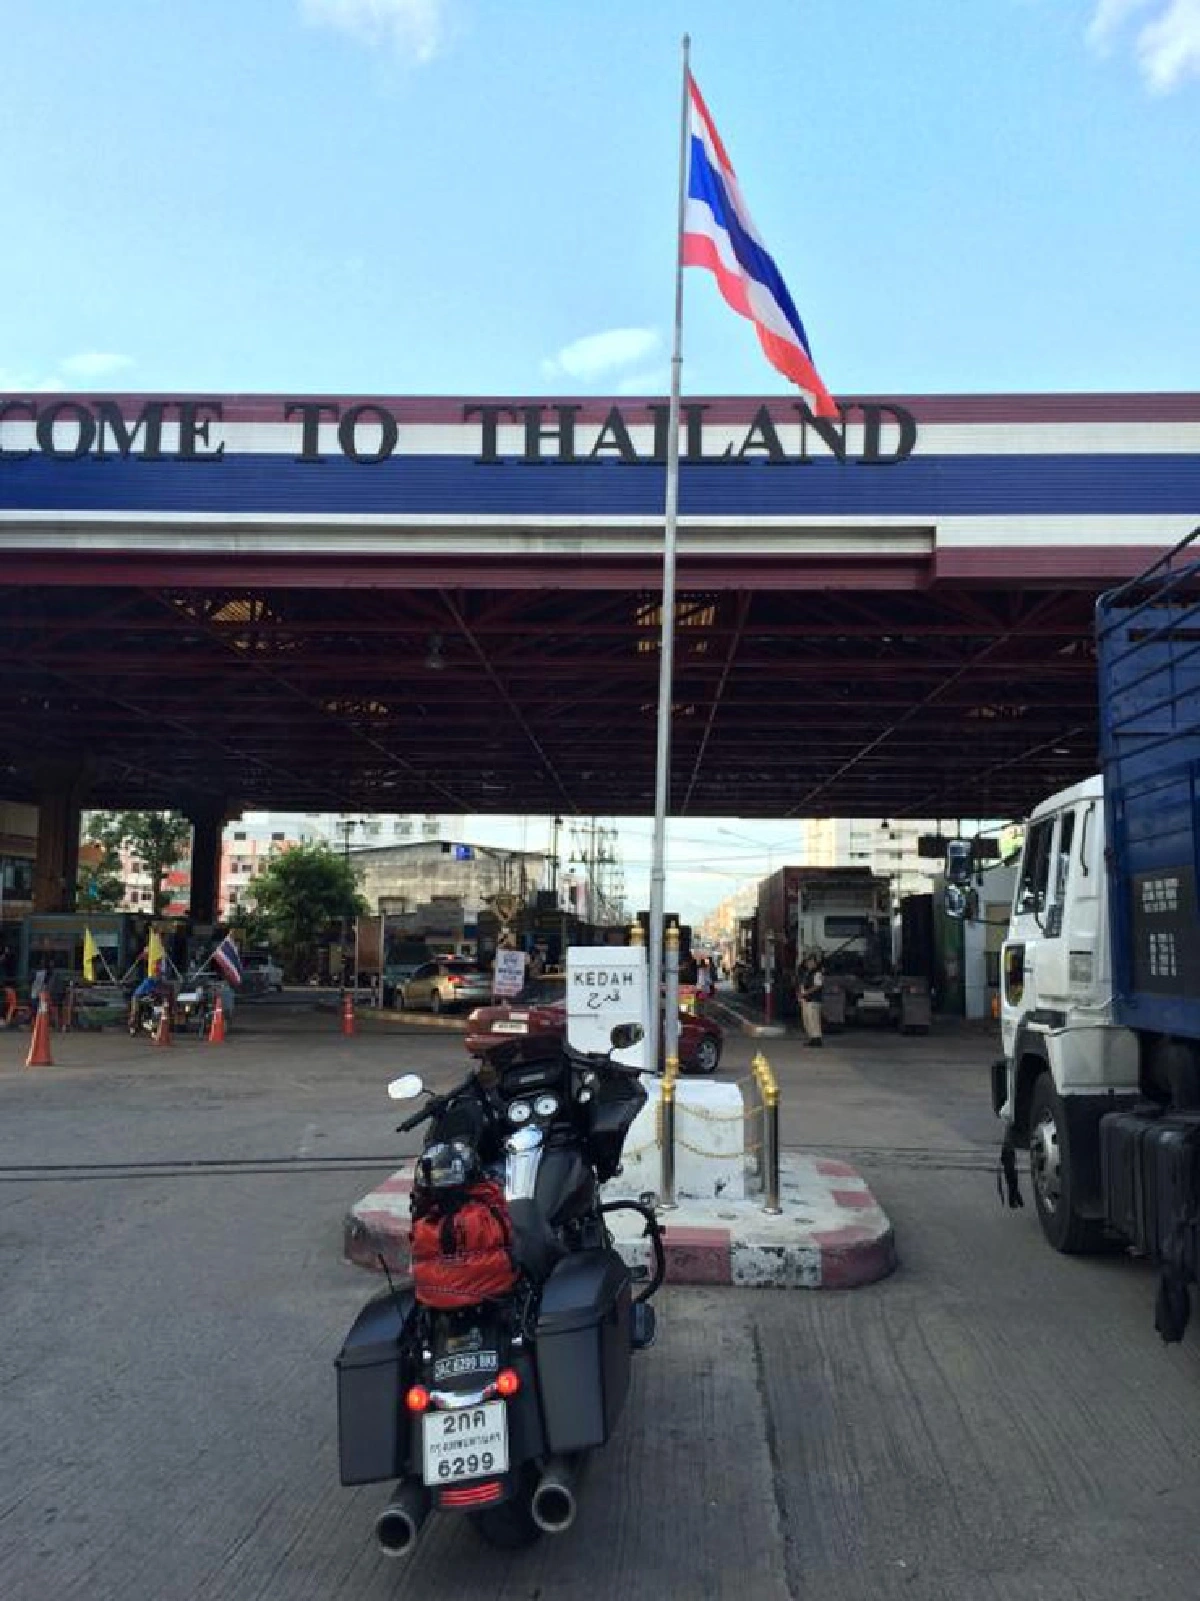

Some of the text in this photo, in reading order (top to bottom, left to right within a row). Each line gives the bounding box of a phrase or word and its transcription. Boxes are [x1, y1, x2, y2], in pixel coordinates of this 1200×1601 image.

[284, 402, 399, 465] TO
[464, 402, 918, 466] THAILAND
[573, 971, 633, 986] KEDAH
[438, 1452, 494, 1478] 6299
